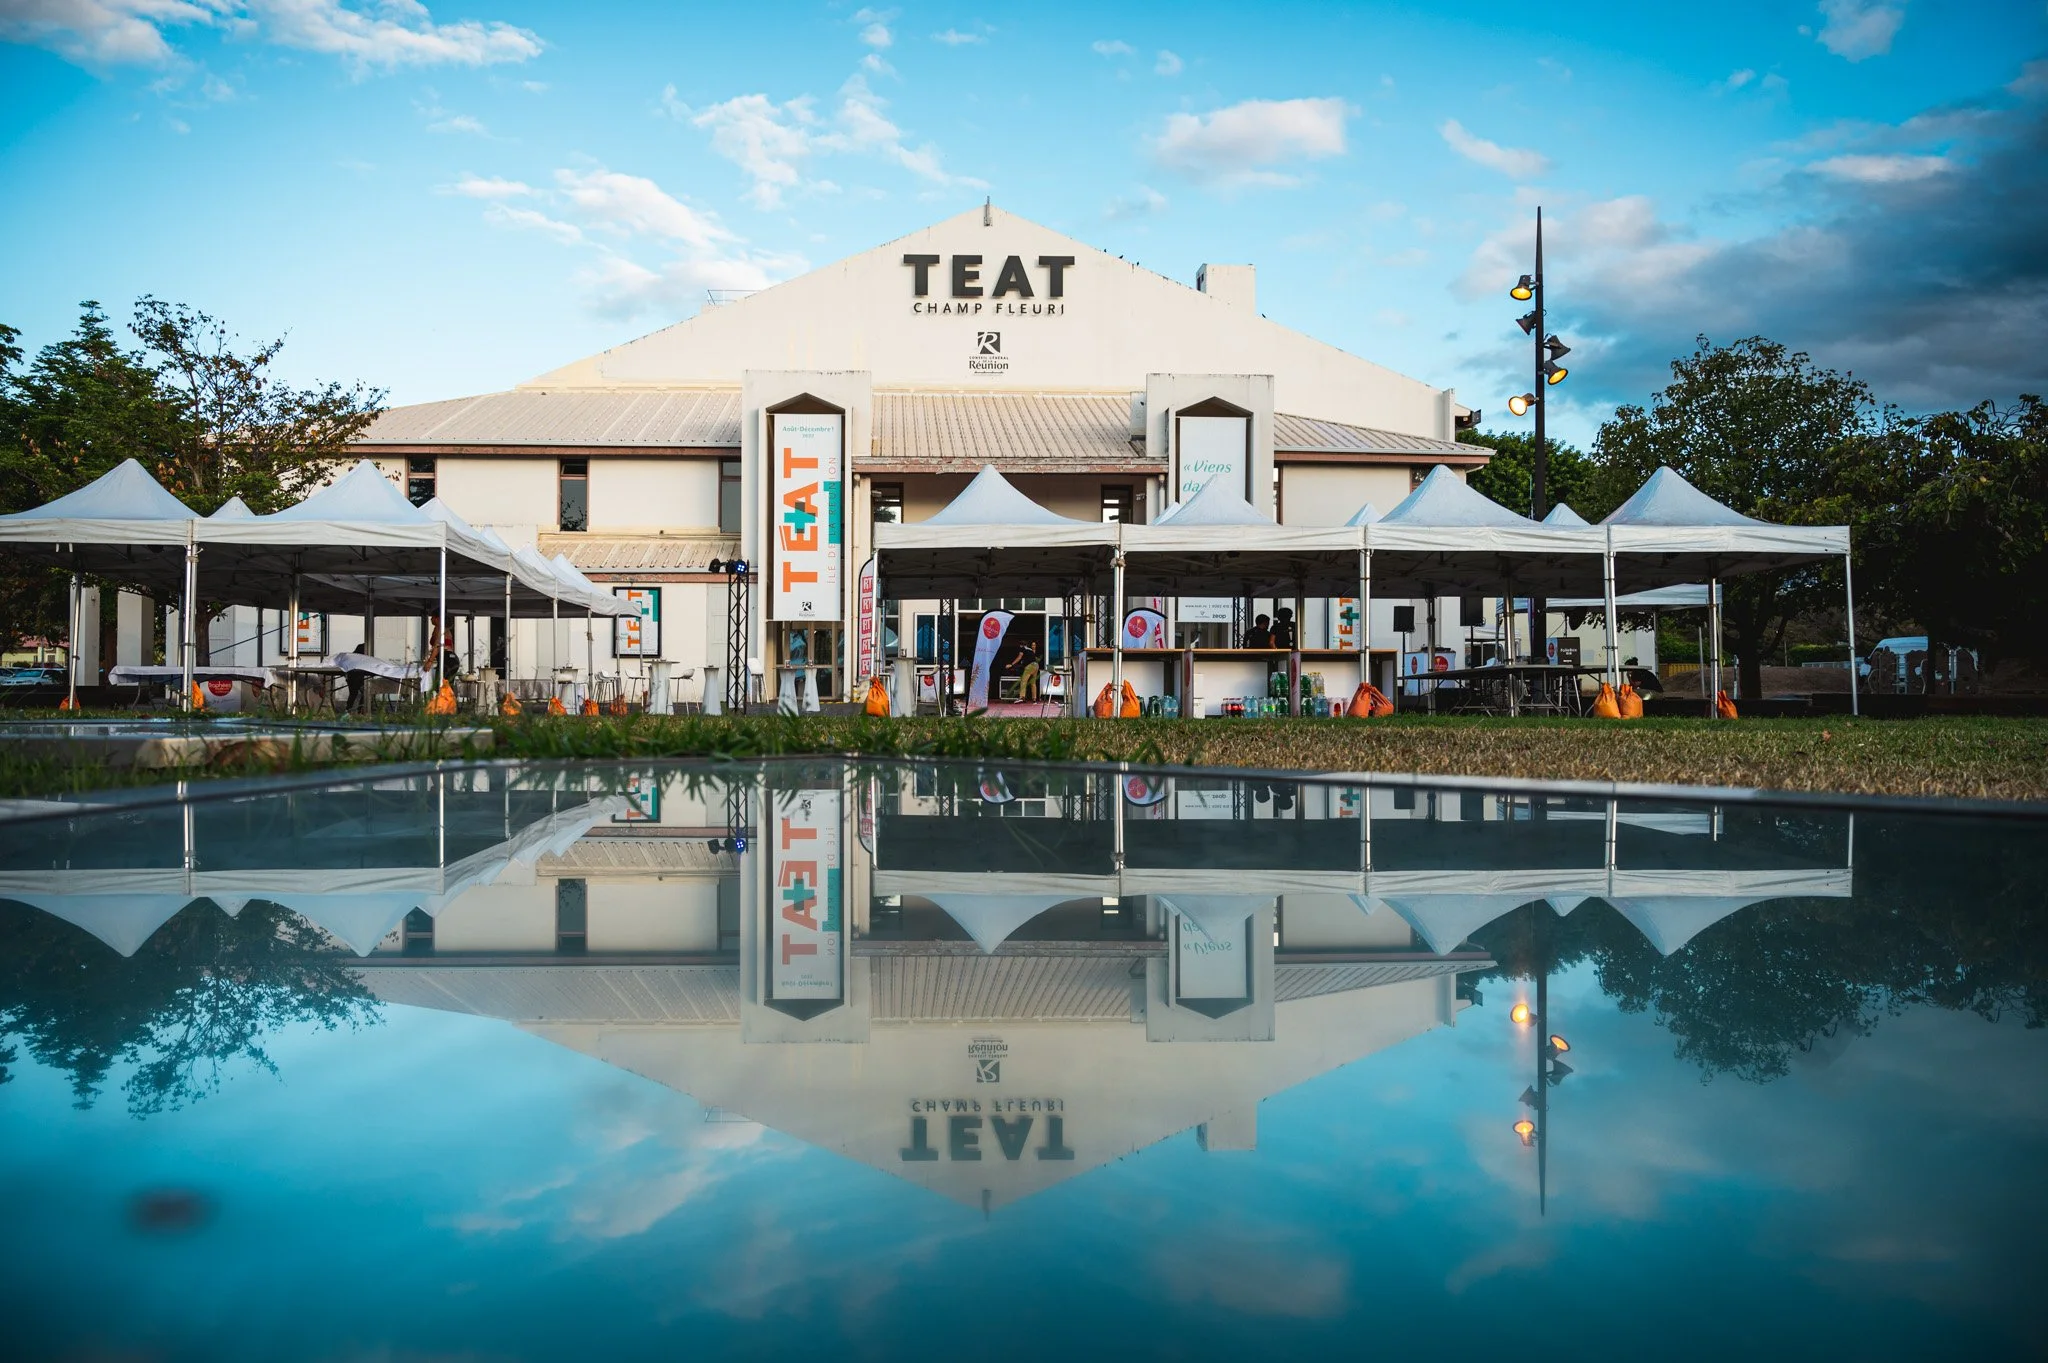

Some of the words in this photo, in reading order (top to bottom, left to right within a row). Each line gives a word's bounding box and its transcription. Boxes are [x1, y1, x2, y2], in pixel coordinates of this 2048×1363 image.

[903, 254, 1075, 297] TEAT
[913, 302, 983, 314] CHAMP
[996, 303, 1065, 315] FLEURI
[969, 360, 1009, 370] Réunion
[1194, 460, 1232, 473] Viens
[828, 543, 836, 558] DE
